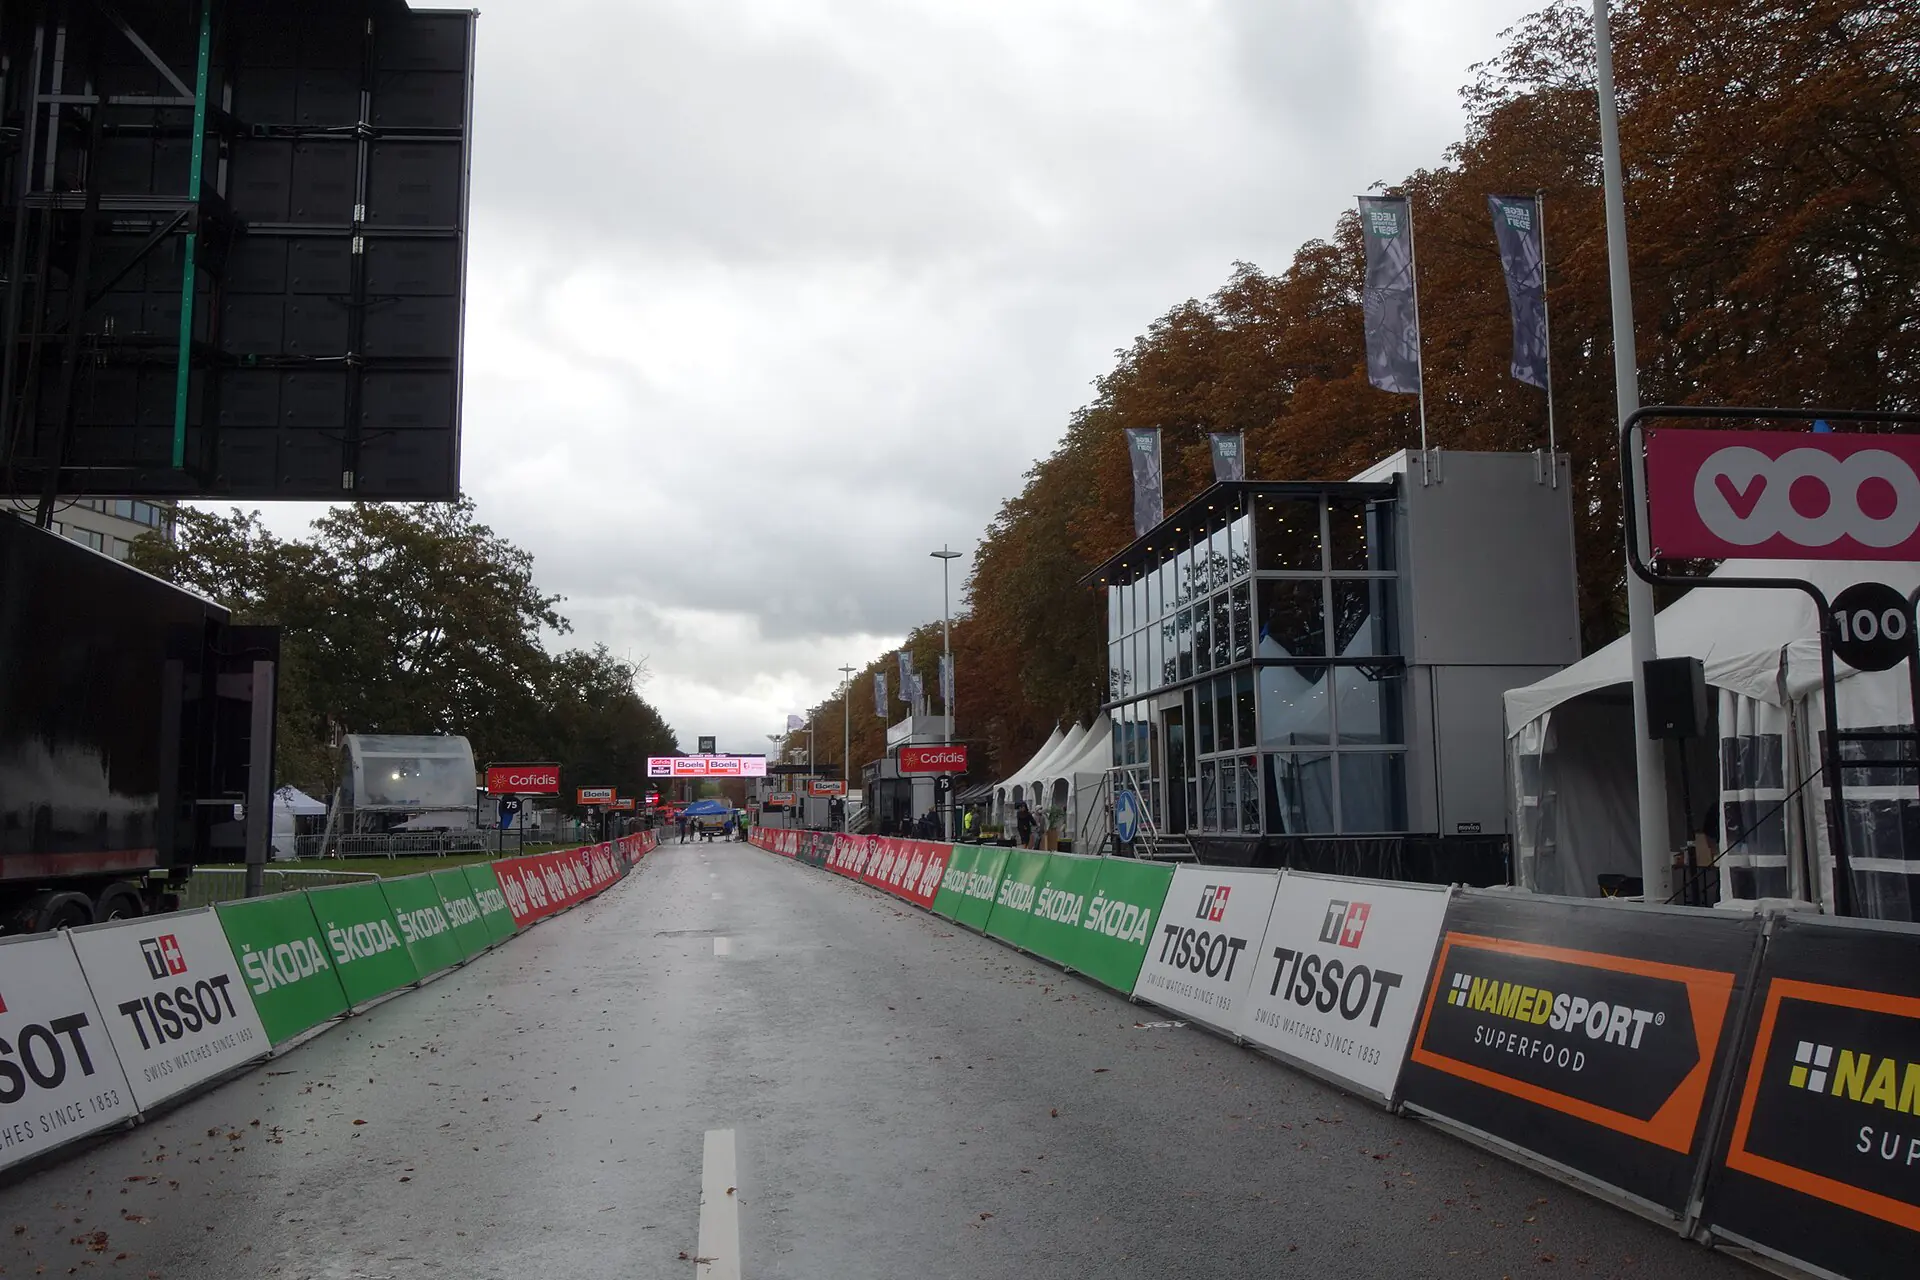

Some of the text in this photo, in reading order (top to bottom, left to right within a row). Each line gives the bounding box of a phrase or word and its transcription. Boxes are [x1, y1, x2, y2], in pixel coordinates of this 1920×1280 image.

[1834, 608, 1906, 642] 100
[509, 774, 556, 786] Cofidis
[920, 752, 965, 764] Cofidis
[940, 779, 949, 788] 75
[519, 866, 548, 908] lotto
[902, 849, 923, 890] lotto
[918, 852, 943, 898] lotto
[443, 896, 480, 928] ŠKODA
[498, 872, 528, 917] lotto
[997, 874, 1036, 913] ŠKODA
[1034, 882, 1084, 926] ŠKODA
[396, 906, 450, 944] ŠKODA
[1084, 890, 1151, 946] ŠKODA
[327, 919, 400, 964] ŠKODA
[1158, 924, 1247, 982] TISSOT
[242, 936, 330, 995] ŠKODA
[1270, 947, 1403, 1028] TISSOT
[118, 974, 237, 1050] TISSOT
[1165, 978, 1192, 997] WATCHES
[1194, 988, 1215, 1005] SINCE
[1216, 995, 1232, 1011] 1853
[144, 1027, 253, 1083] SWISS WATCHES SINCE 1853
[1255, 1008, 1381, 1066] SWISS WATCHES SINCE 1853
[1474, 1024, 1586, 1072] SUPERFOOD
[0, 1090, 120, 1150] HES SINCE 1853
